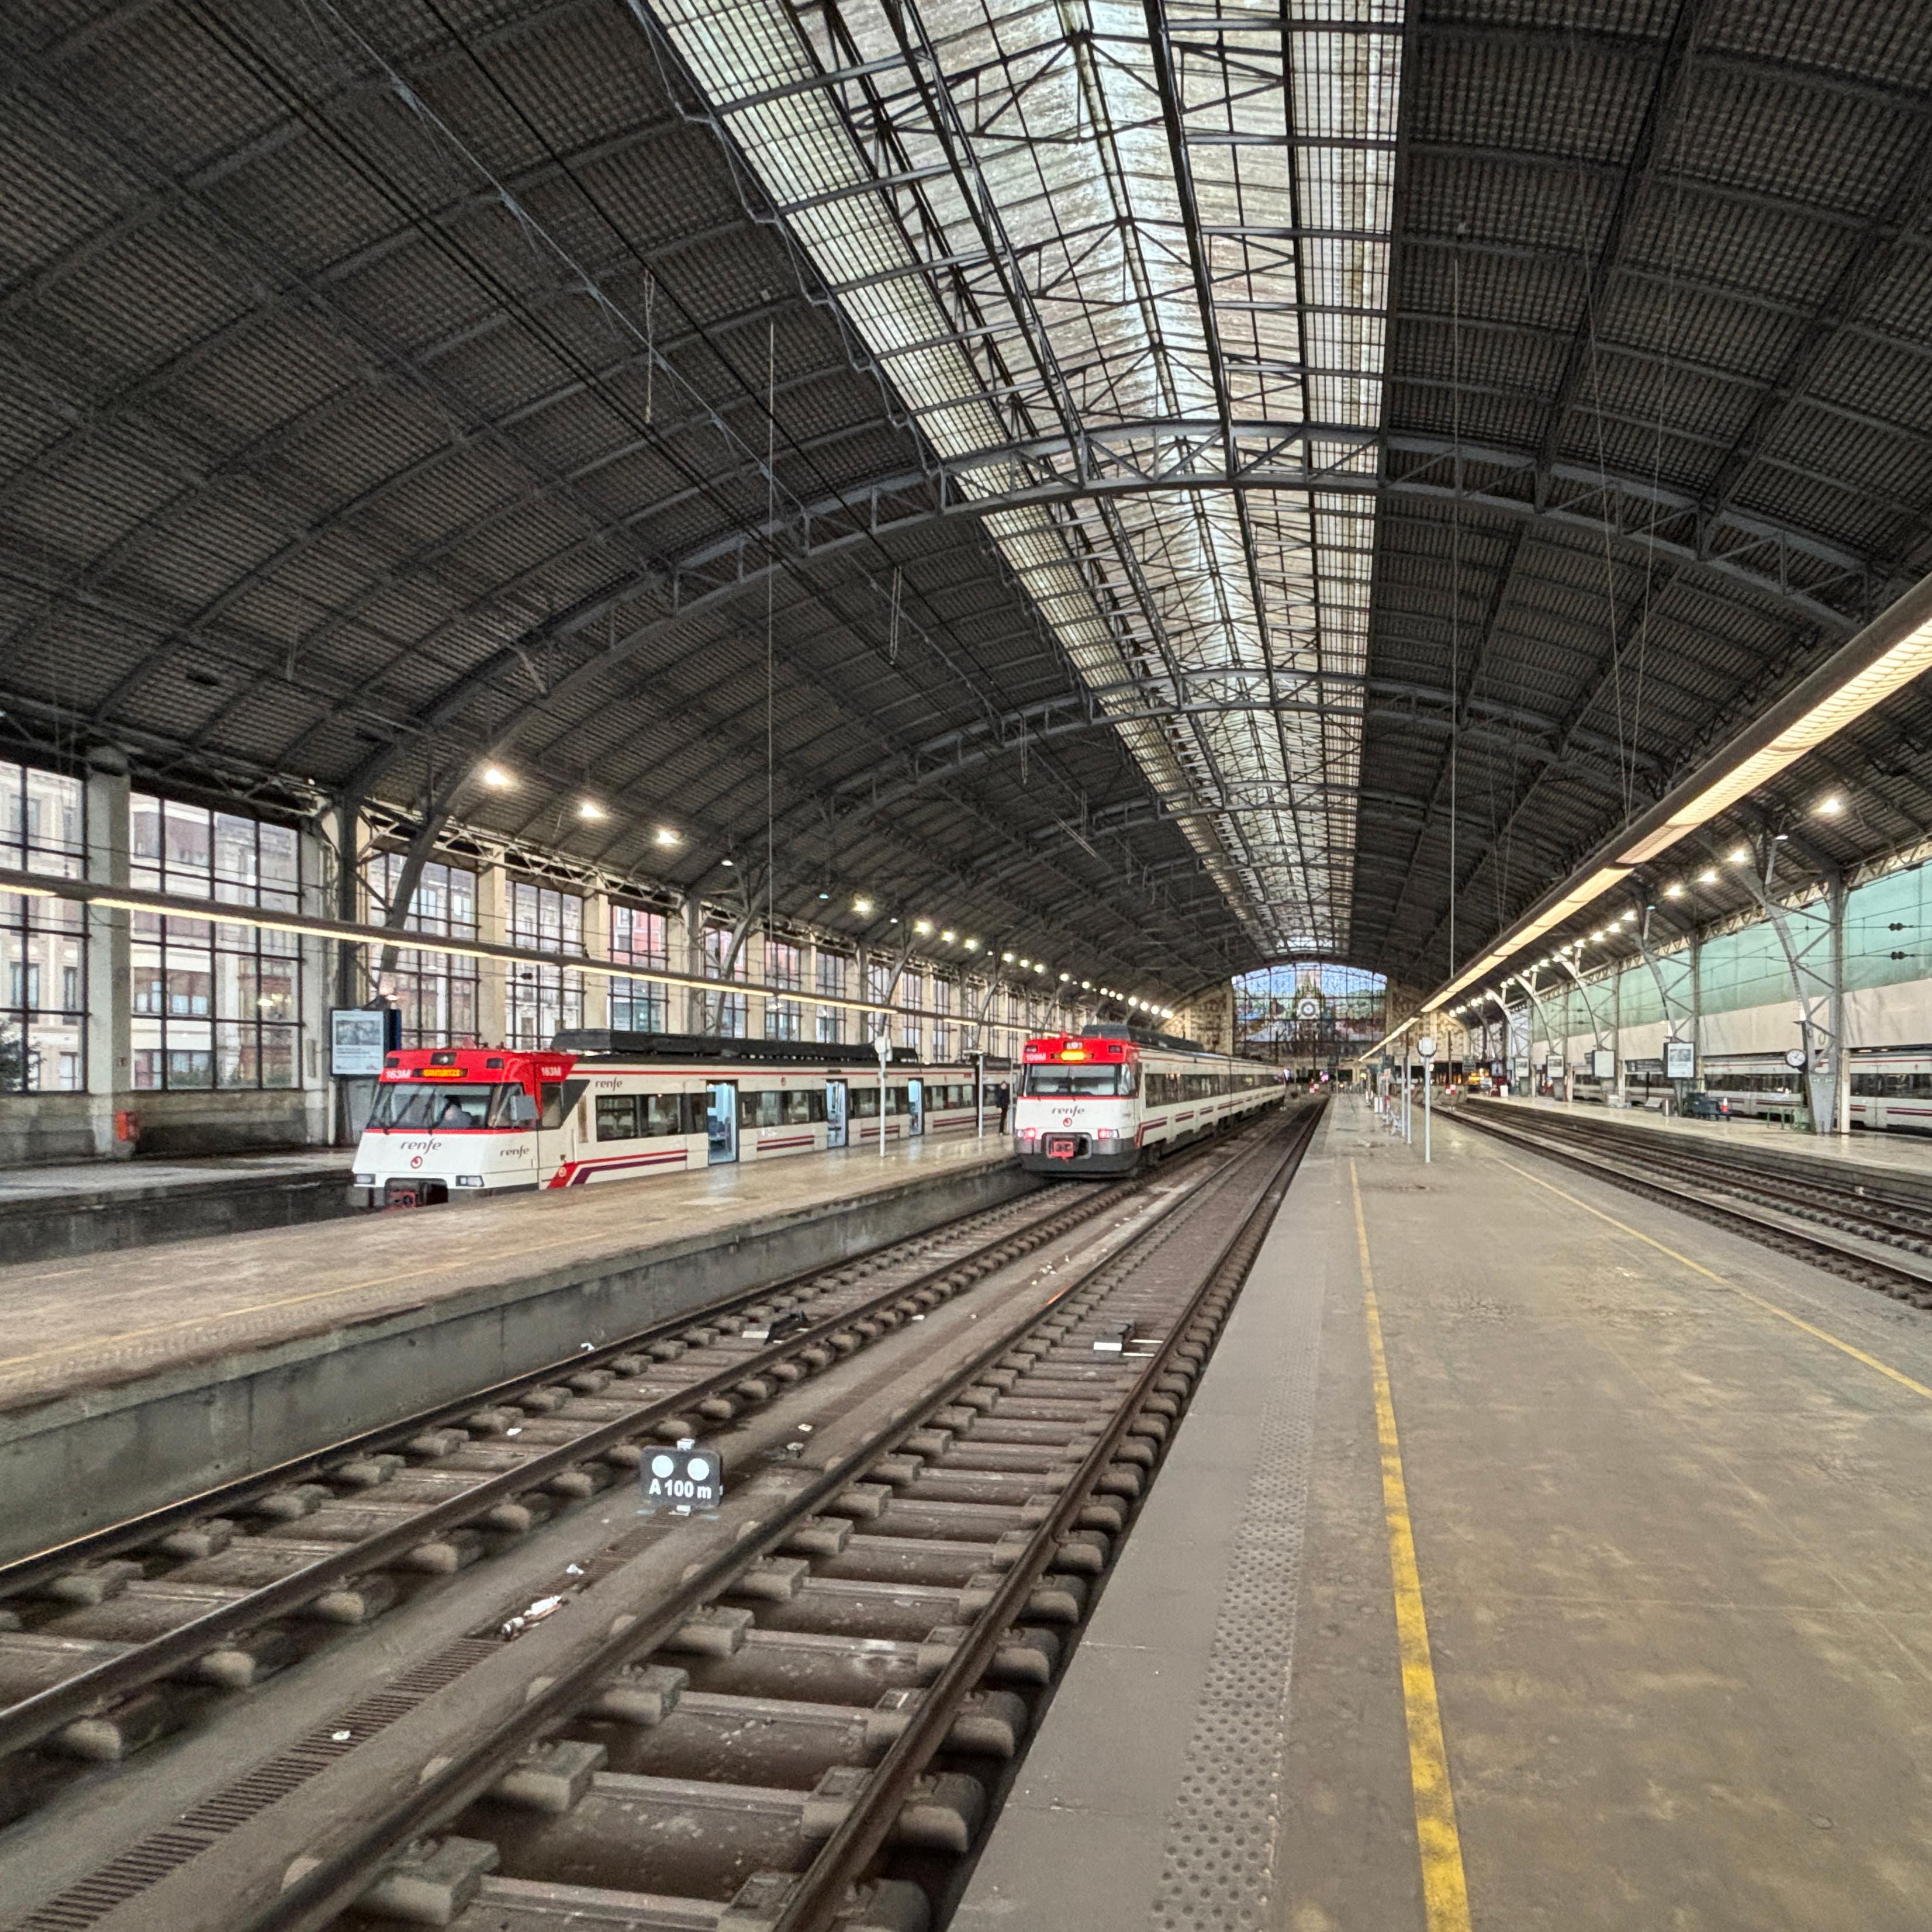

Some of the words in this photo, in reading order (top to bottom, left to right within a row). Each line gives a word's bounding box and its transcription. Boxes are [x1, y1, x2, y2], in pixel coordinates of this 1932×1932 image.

[386, 1069, 412, 1079] 163M
[595, 1077, 623, 1091] renfe
[1052, 1105, 1086, 1118] renfe
[400, 1138, 443, 1155] renfe
[500, 1145, 531, 1159] renfe
[648, 1478, 662, 1495] A
[664, 1479, 694, 1498] 100
[697, 1485, 712, 1499] m
